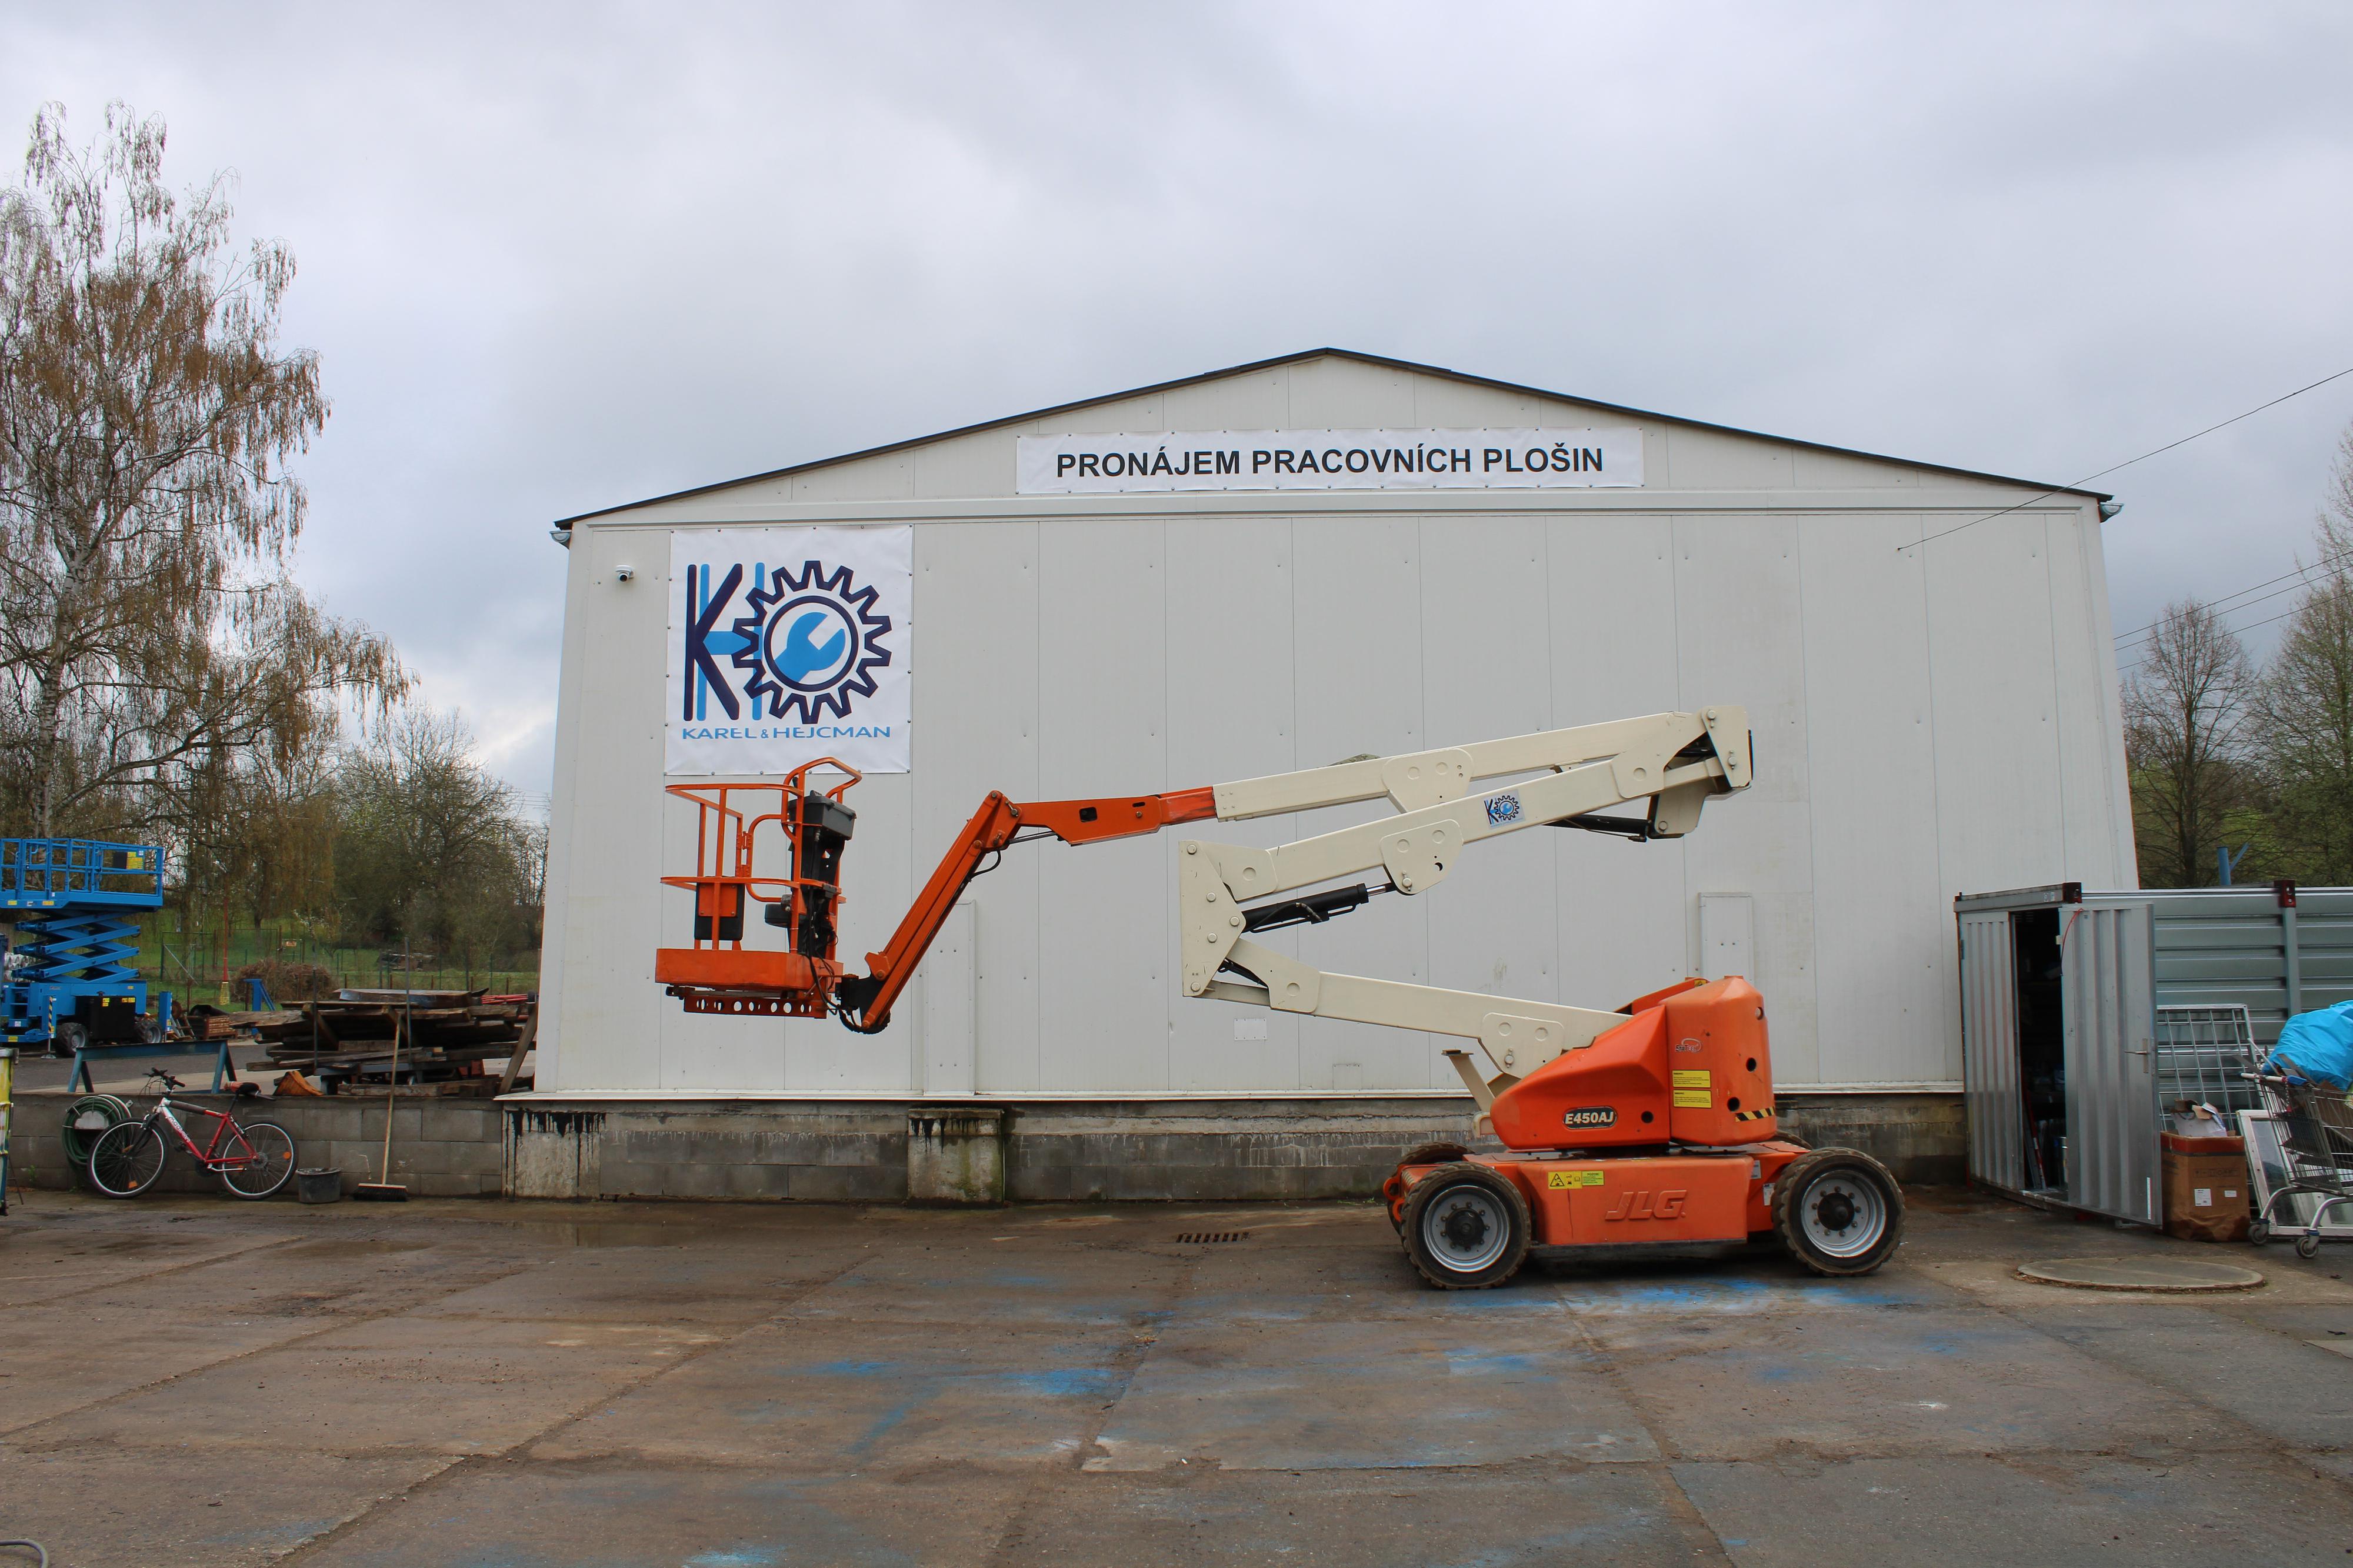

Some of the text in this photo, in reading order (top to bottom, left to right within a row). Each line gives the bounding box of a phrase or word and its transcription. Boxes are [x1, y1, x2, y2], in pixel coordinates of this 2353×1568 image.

[1057, 442, 1602, 477] PRONÁJEM PRACOVNÍCH PLOŠIN
[682, 726, 891, 739] KAREL & HEJCMAN
[1565, 1112, 1614, 1124] E450AJ
[1605, 1190, 1687, 1220] JLG
